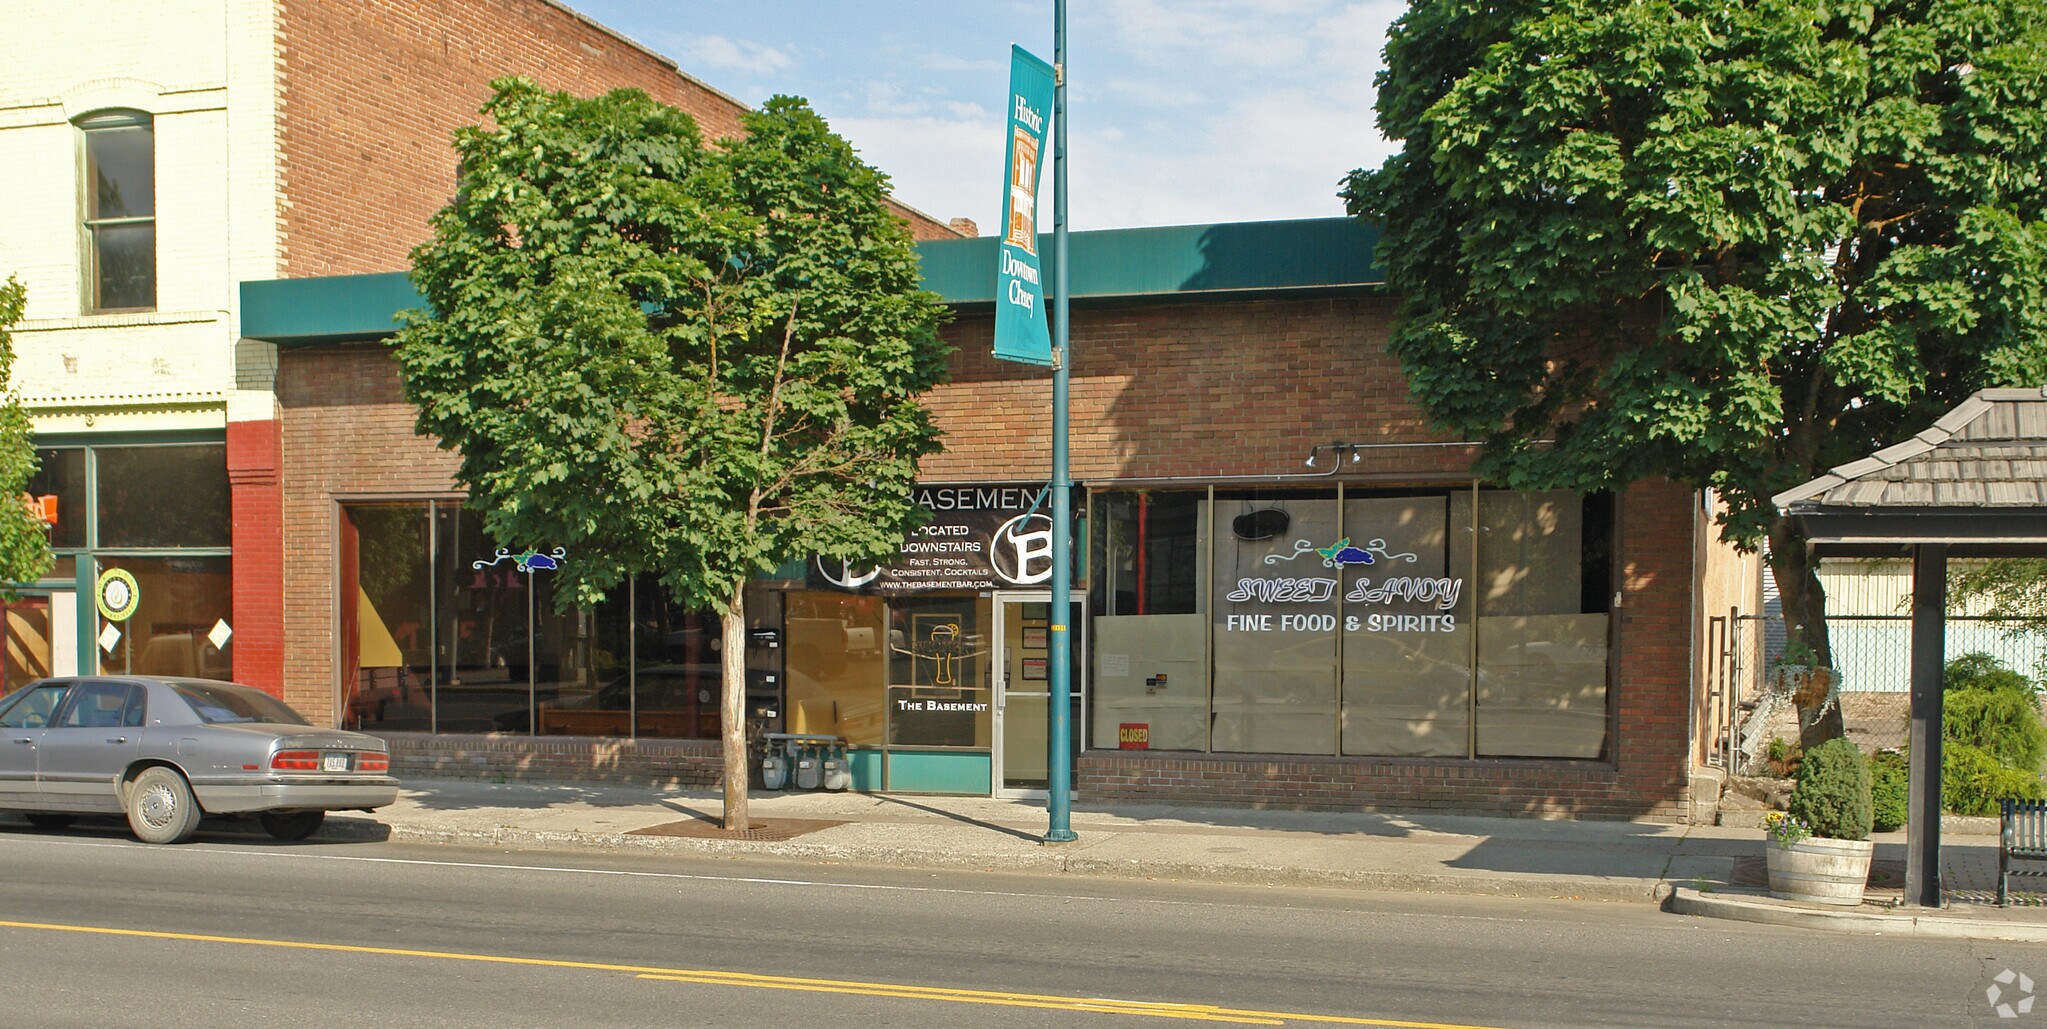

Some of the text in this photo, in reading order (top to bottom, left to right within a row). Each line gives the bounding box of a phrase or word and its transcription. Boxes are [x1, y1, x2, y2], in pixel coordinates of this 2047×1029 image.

[1014, 93, 1043, 134] Historic
[900, 542, 981, 553] DOWNSTAIRS
[944, 568, 989, 576] COCKTAILS
[880, 580, 993, 589] WWW.THEBASEMENTBAR.COM
[1226, 577, 1463, 610] SWEET SAVOY
[1227, 613, 1456, 632] FINE FOOD & SPIRITS
[898, 700, 988, 712] THE BASEMENT
[1120, 728, 1148, 742] CLOSED
